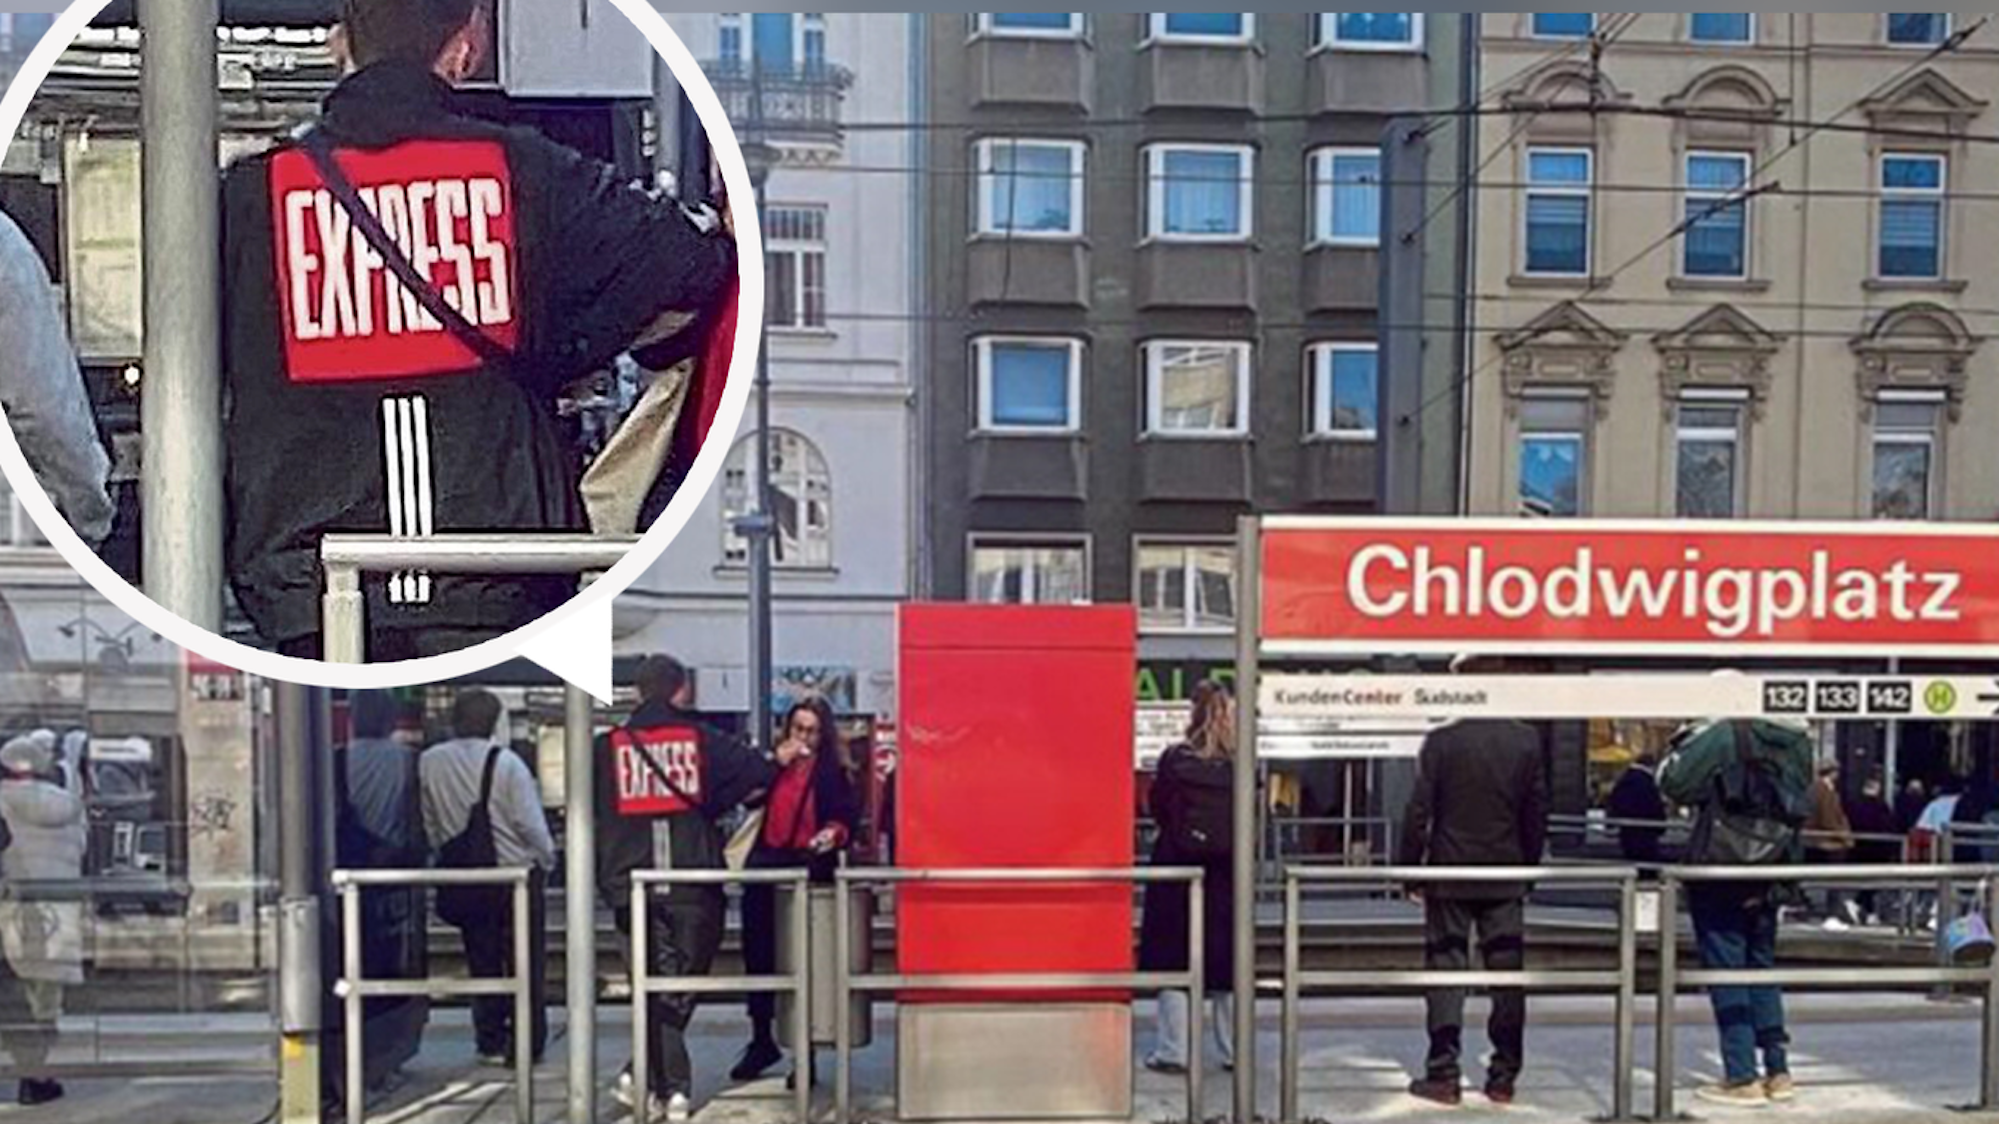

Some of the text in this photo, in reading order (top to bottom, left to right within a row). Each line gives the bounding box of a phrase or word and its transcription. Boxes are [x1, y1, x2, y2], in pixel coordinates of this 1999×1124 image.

[285, 178, 512, 339] EXPRESS
[1346, 544, 1962, 639] Chlodwigplatz
[1274, 687, 1403, 705] KundenCenter
[1766, 687, 1805, 709] 132
[1818, 687, 1858, 709] 133
[1870, 687, 1909, 709] 142
[617, 741, 699, 799] EXPRESS
